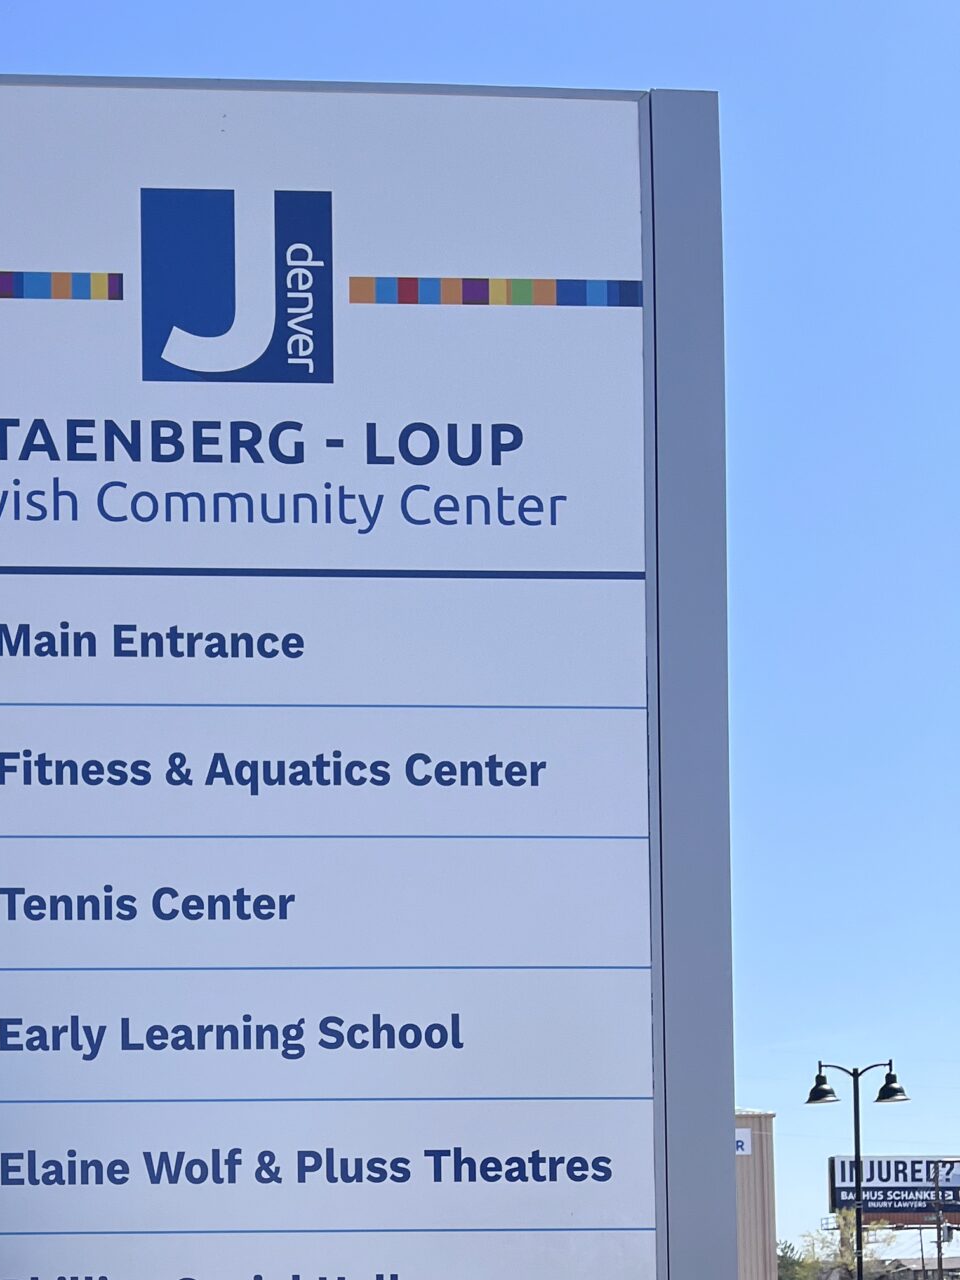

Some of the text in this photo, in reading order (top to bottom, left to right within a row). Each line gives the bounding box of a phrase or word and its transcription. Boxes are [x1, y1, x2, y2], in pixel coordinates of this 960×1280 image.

[161, 190, 276, 372] J
[286, 243, 324, 373] denver
[325, 437, 345, 449] -
[367, 422, 523, 466] LOUP
[97, 481, 384, 534] Community
[401, 485, 567, 526] Center
[114, 625, 304, 658] Entrance
[166, 752, 193, 785] &
[205, 750, 390, 795] Aquatics
[406, 753, 546, 786] Center
[152, 887, 295, 920] Center
[0, 1014, 464, 1061] Early Learning School
[1, 1147, 612, 1185] Elaine Wolf & Pluss Theatres
[841, 1191, 883, 1200] BAHUS
